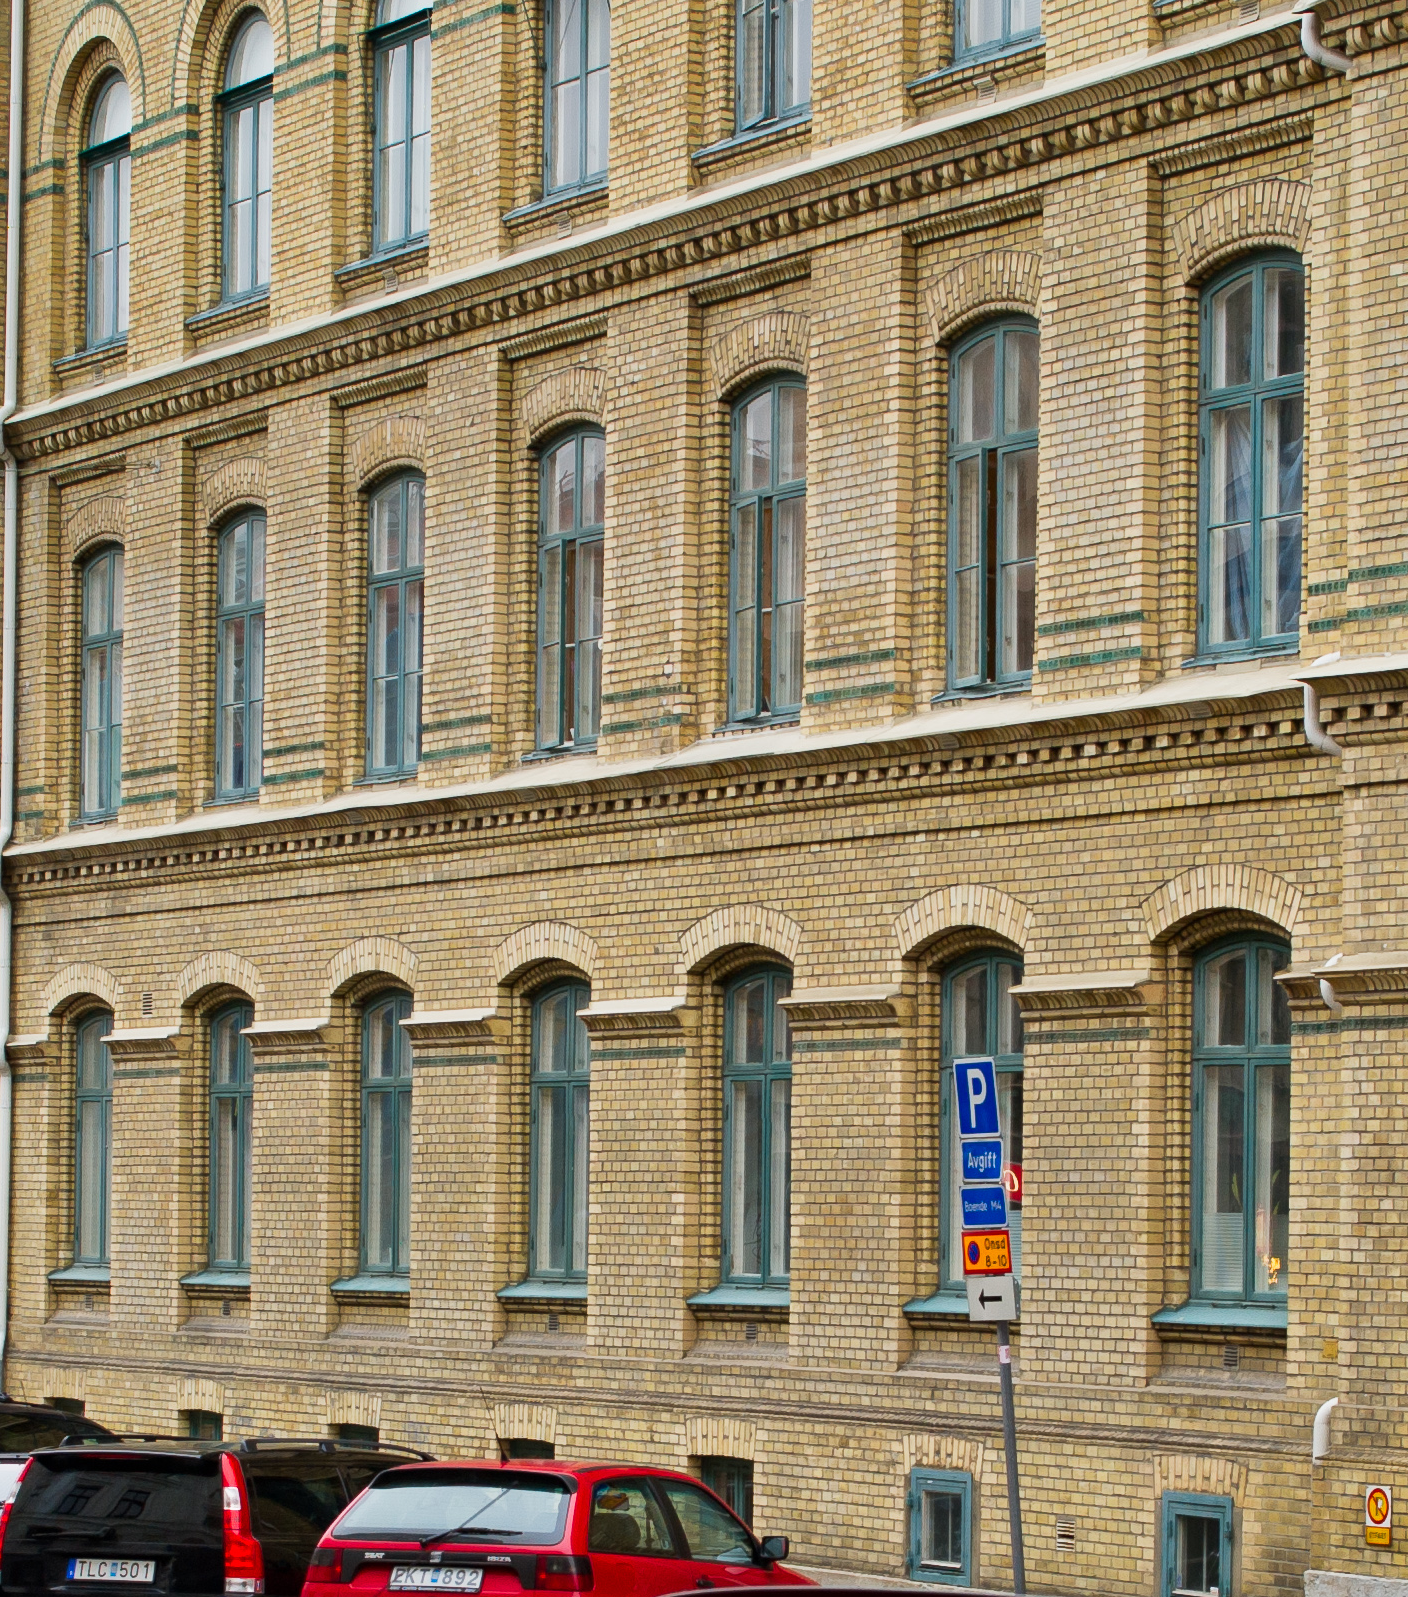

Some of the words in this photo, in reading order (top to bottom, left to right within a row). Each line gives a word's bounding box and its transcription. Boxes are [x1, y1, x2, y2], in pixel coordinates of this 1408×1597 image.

[966, 1068, 987, 1128] P
[967, 1152, 997, 1173] Avgift
[964, 1200, 988, 1212] Boende
[984, 1237, 1006, 1250] Onsd
[985, 1254, 1007, 1268] 8-10
[78, 1560, 107, 1578] TLC
[119, 1561, 151, 1579] 501
[441, 1569, 480, 1586] 892
